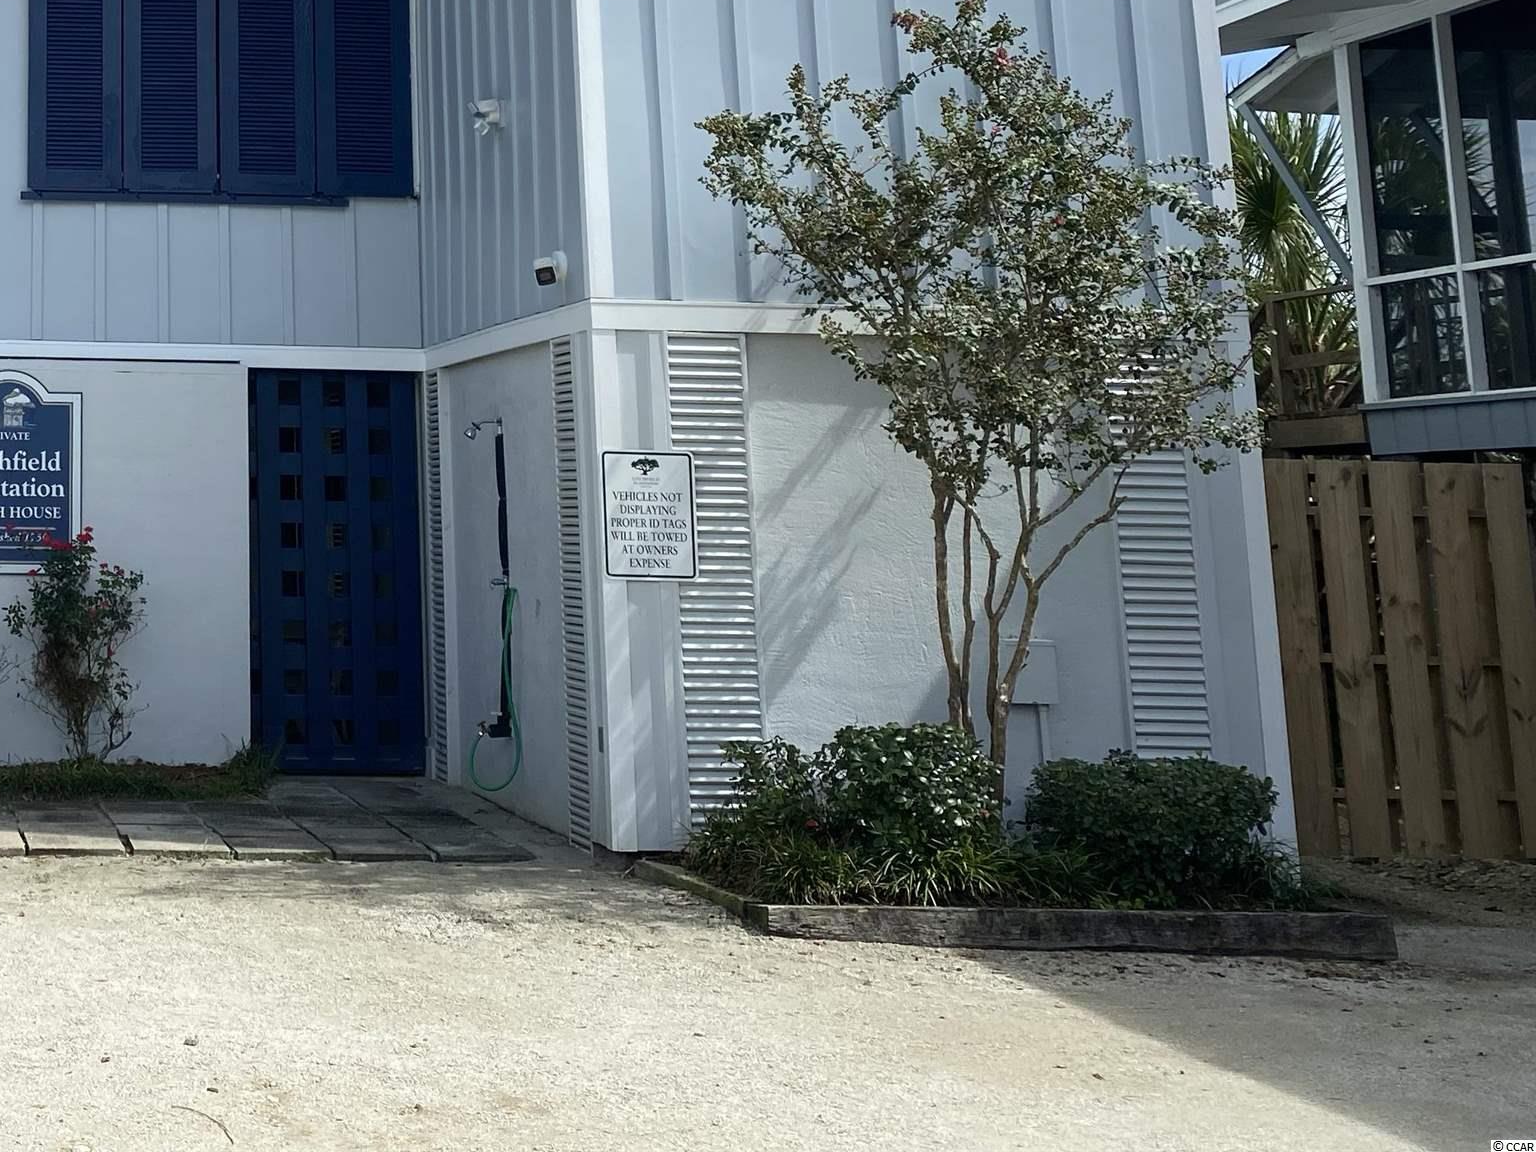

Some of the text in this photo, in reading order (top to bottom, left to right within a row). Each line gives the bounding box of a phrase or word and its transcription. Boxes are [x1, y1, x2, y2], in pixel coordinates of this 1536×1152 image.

[612, 491, 683, 502] VEHICLES NOT
[9, 506, 62, 519] HOUSE
[619, 504, 677, 515] DISPLAYING
[610, 517, 687, 529] PROPER ID TAGS
[610, 531, 688, 542] WILL BE TOWED
[622, 545, 678, 556] AT OWNERS
[629, 558, 671, 568] EXPENSE
